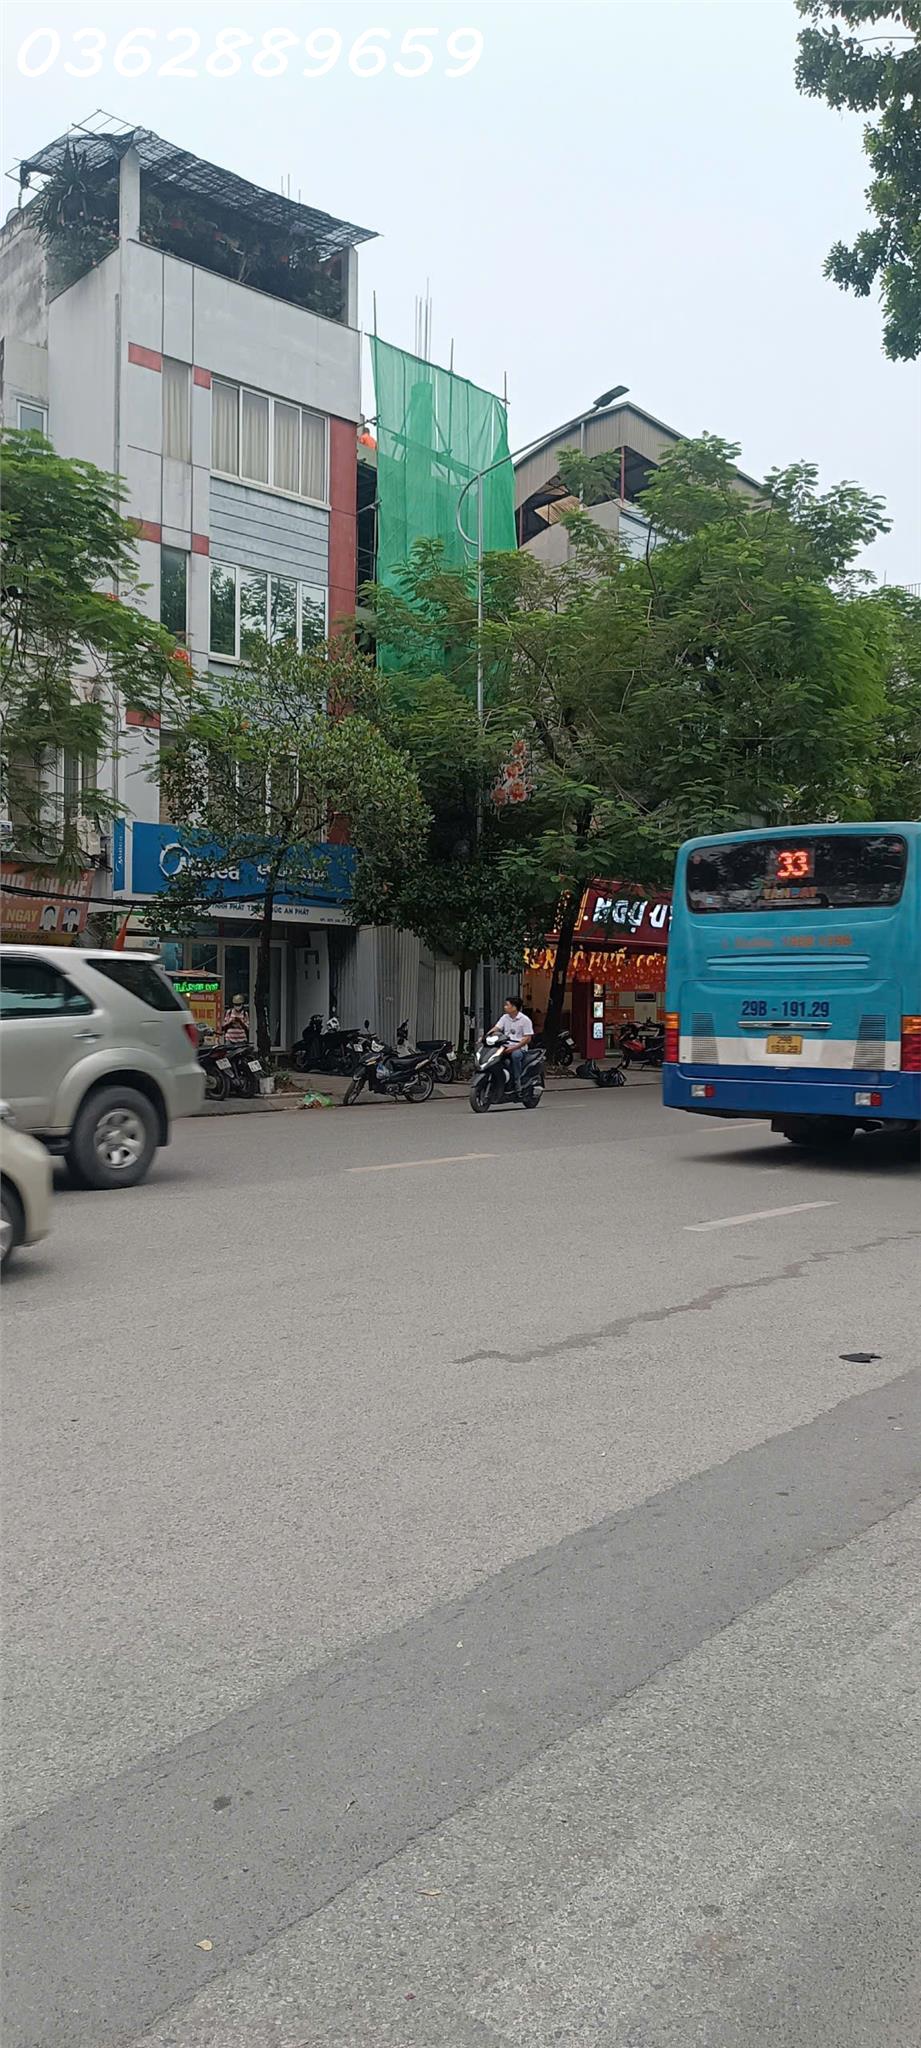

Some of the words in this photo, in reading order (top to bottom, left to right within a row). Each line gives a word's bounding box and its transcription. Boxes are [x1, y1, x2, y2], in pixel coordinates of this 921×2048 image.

[776, 851, 810, 878] 33
[6, 908, 39, 923] NGAY
[741, 1000, 768, 1017] 29B
[782, 1000, 831, 1018] 191.29
